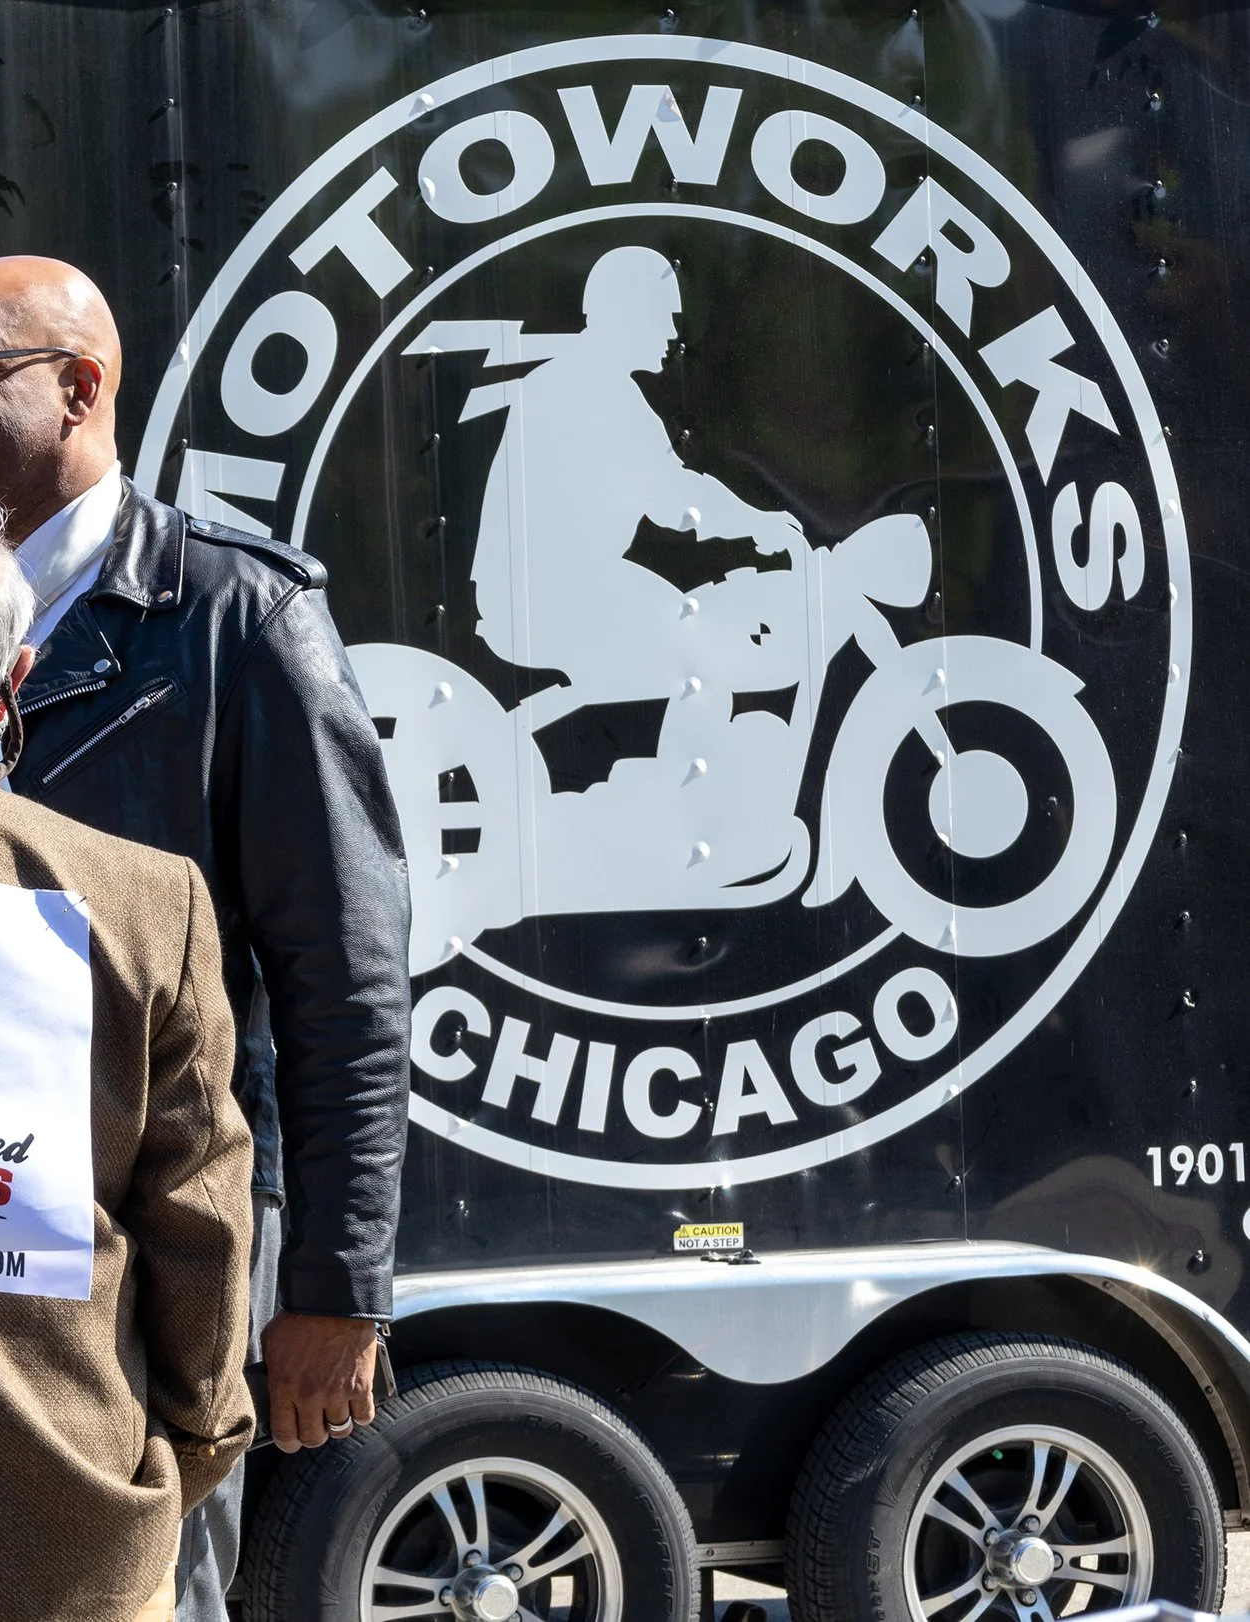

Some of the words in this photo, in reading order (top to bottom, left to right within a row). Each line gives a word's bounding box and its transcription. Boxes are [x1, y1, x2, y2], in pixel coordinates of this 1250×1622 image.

[408, 966, 959, 1140] CHICAGO
[1146, 1142, 1246, 1187] 1901
[678, 1239, 701, 1248] NOT
[702, 1238, 710, 1248] A
[713, 1237, 740, 1248] STEP
[692, 1225, 740, 1237] CAUTION
